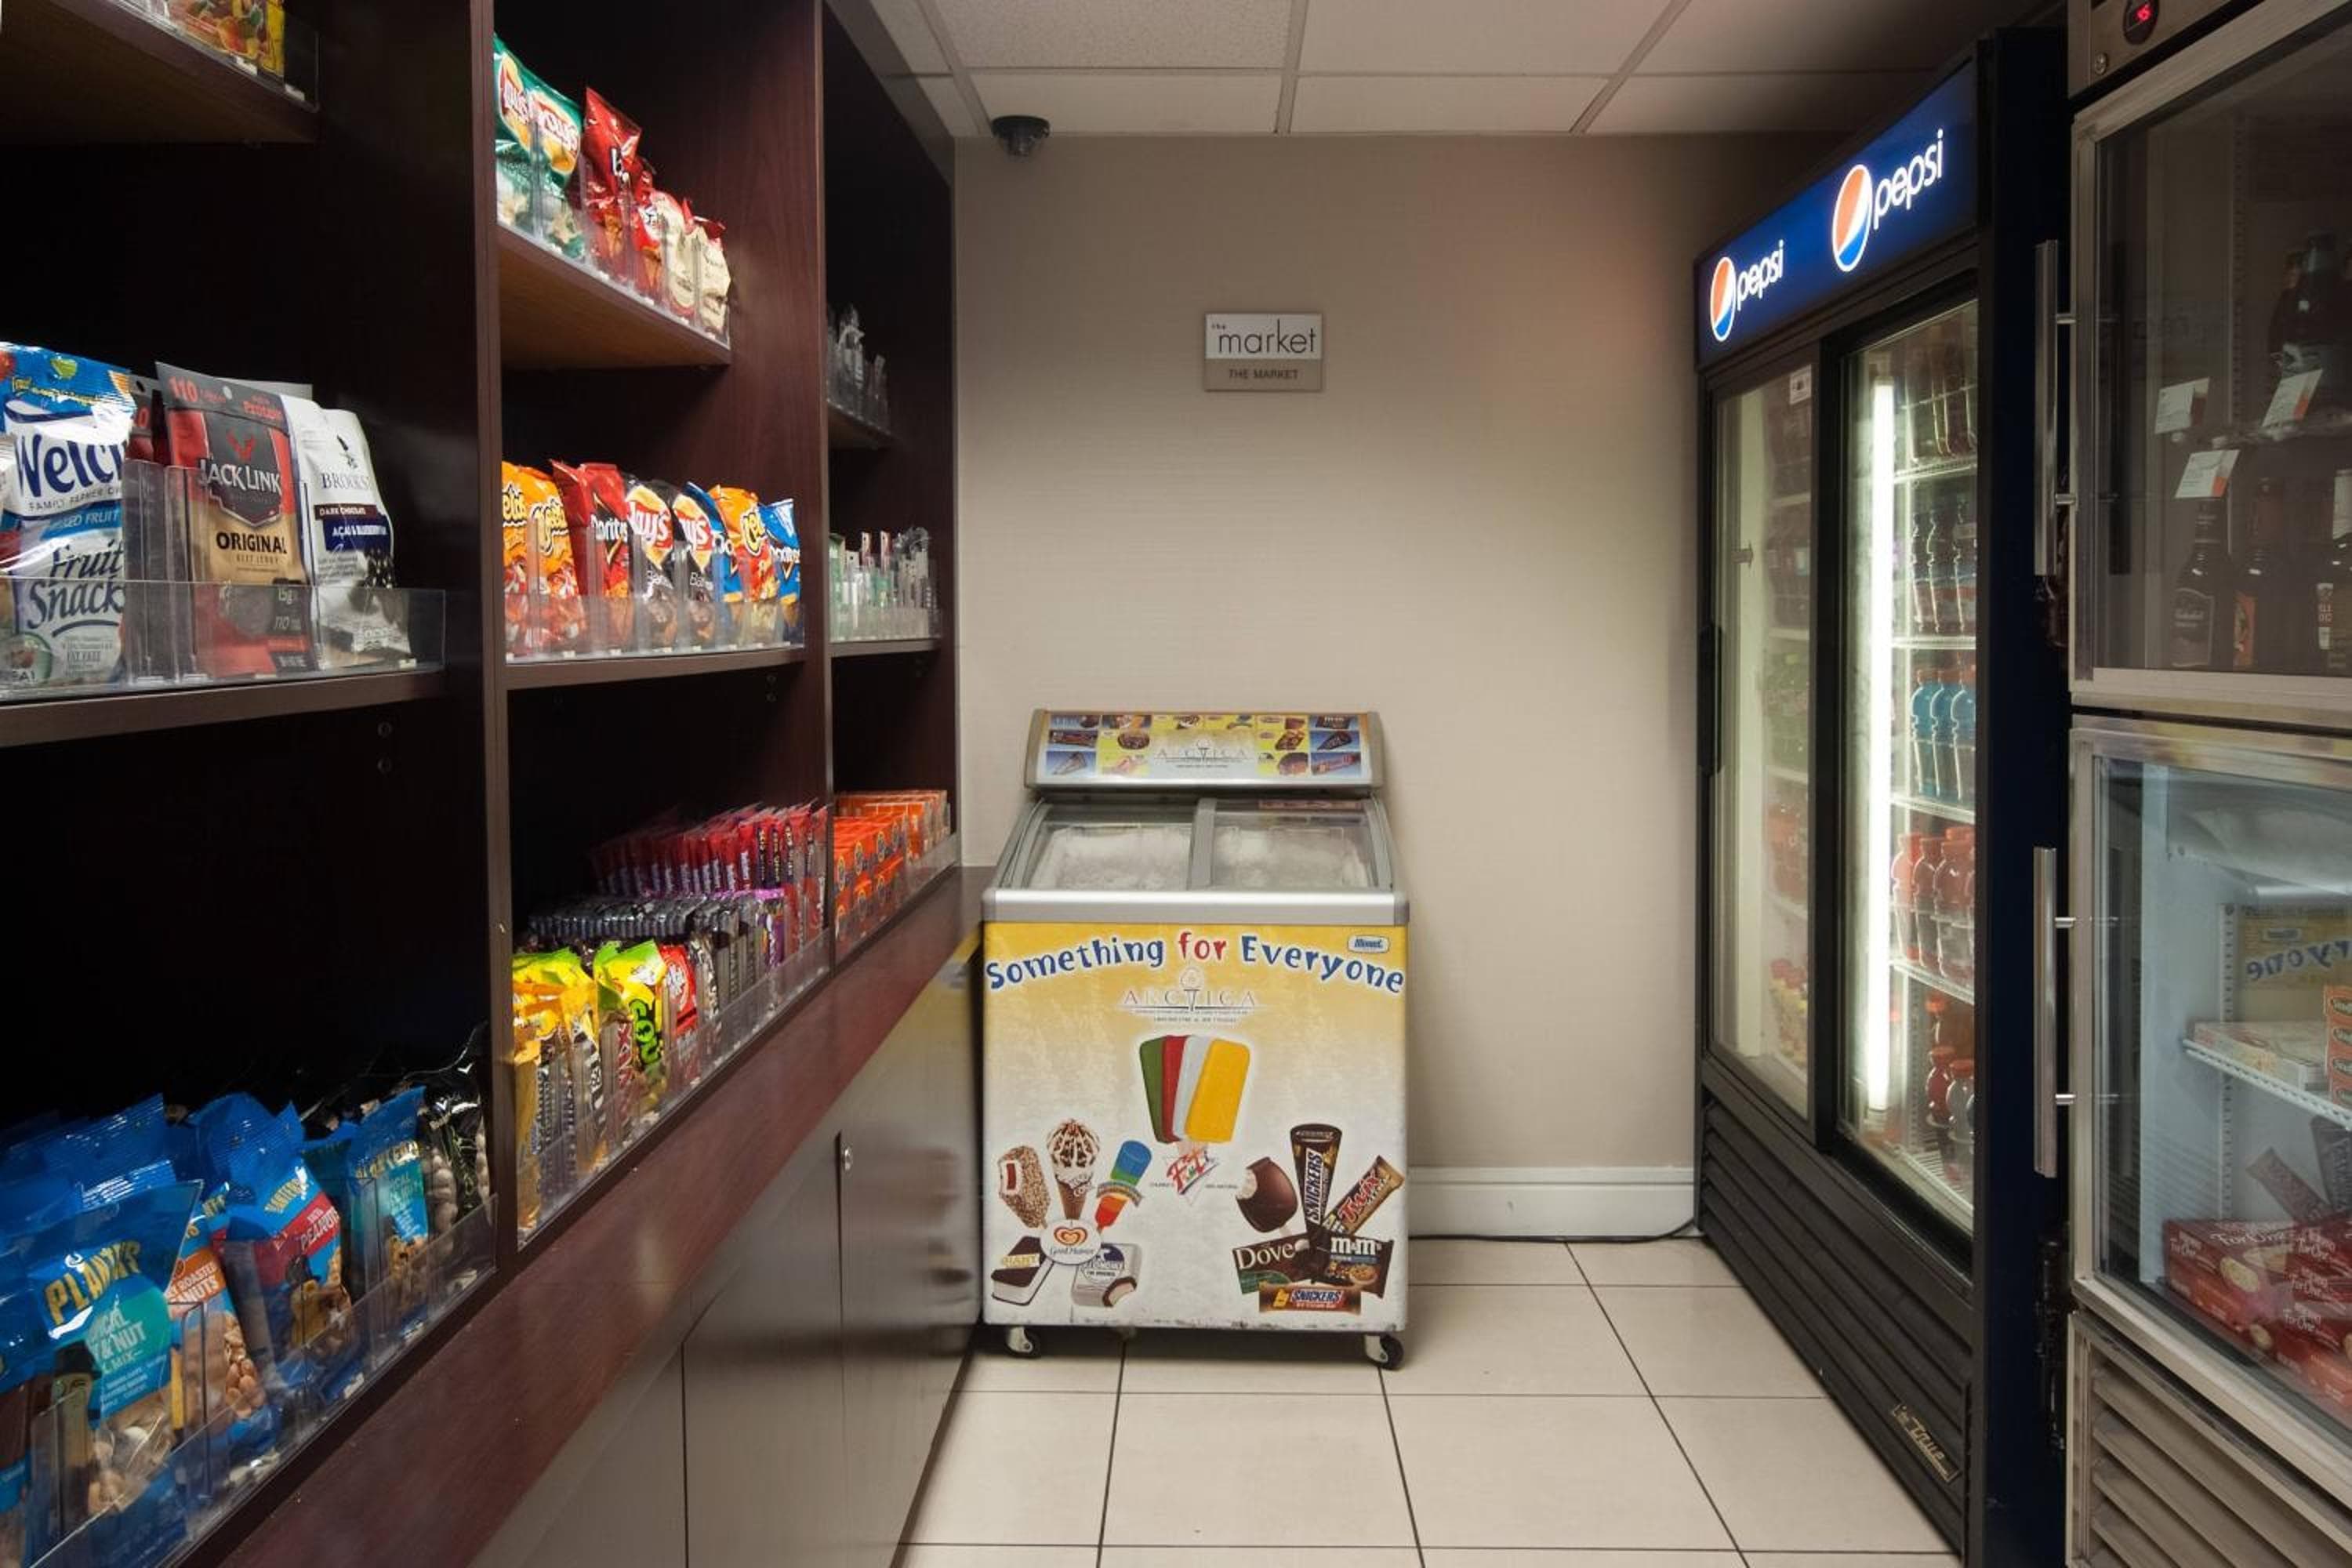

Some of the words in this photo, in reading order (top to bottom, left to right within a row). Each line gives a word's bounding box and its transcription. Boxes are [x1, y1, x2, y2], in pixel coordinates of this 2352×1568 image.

[1873, 129, 1944, 230] pepsi
[1737, 239, 1784, 311] pepsi
[1219, 318, 1316, 354] market
[1229, 368, 1249, 379] THE
[1254, 368, 1299, 379] MARKET
[27, 575, 125, 629] Snack
[985, 937, 1164, 989] Something
[1178, 931, 1227, 961] for
[1241, 935, 1404, 994] Everyone
[1305, 1149, 1323, 1224] SNICKERS
[1235, 1241, 1296, 1269] Dove
[1292, 1290, 1341, 1302] SNICKERS
